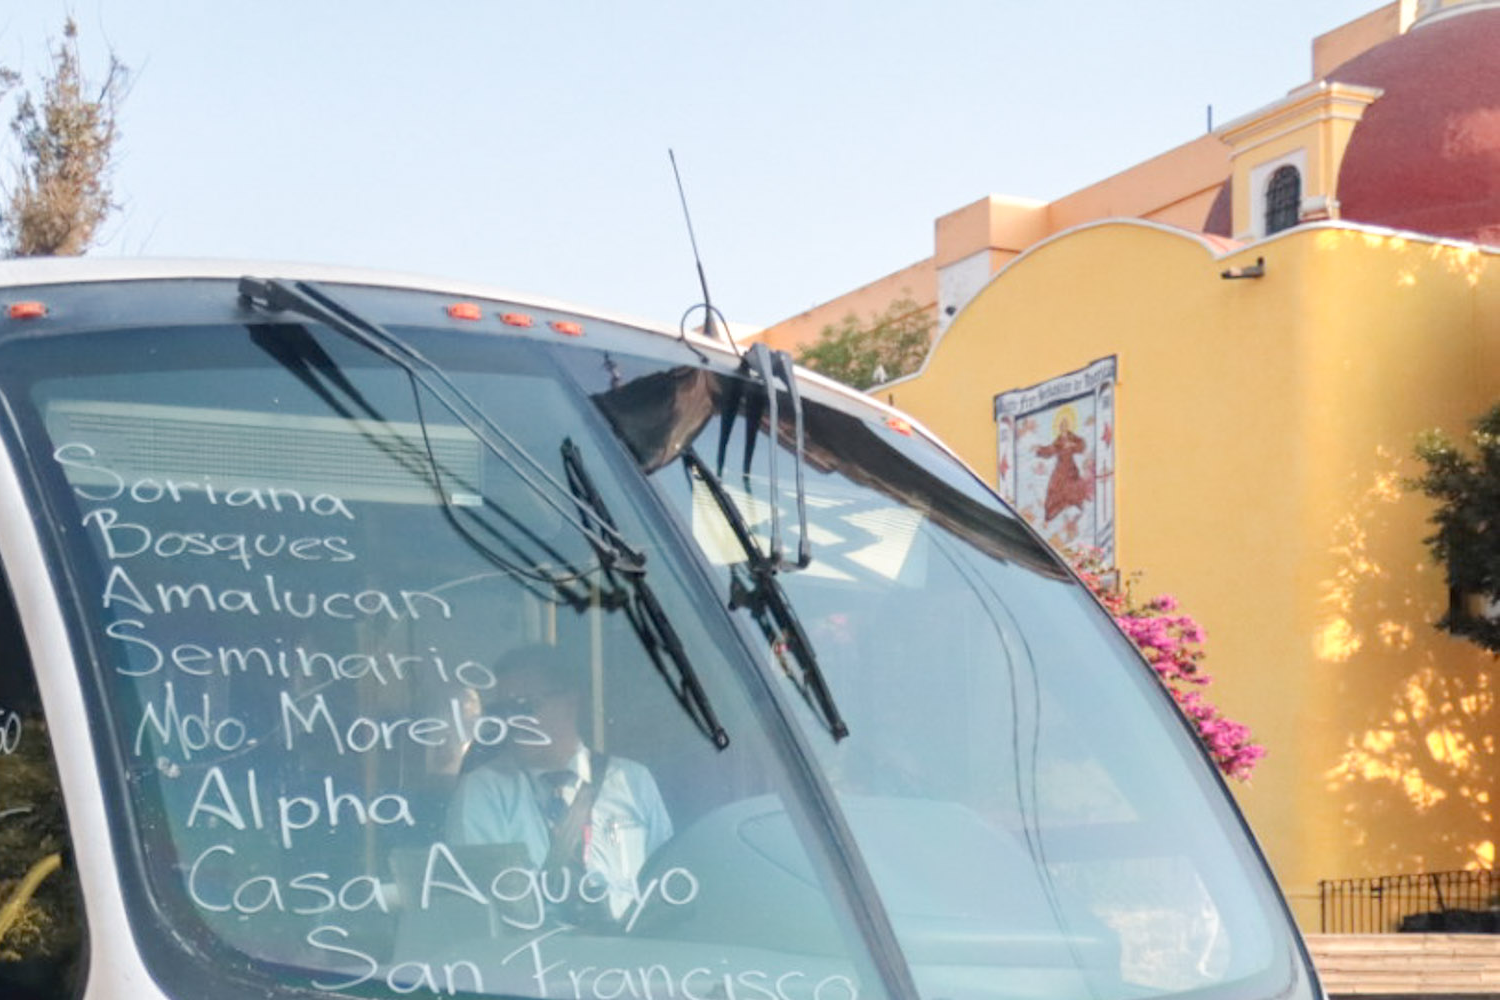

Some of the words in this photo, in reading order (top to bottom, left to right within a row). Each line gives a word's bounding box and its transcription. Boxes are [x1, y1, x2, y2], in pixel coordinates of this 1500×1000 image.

[53, 443, 356, 520] Soriana
[83, 508, 356, 571] Bosques
[101, 565, 451, 619] Amalucan
[104, 619, 497, 690] Seminario
[278, 690, 553, 755] Morelos
[186, 767, 415, 848] Alpha
[187, 845, 390, 917] Casa
[420, 841, 700, 933] Aguayo
[307, 924, 484, 996] San
